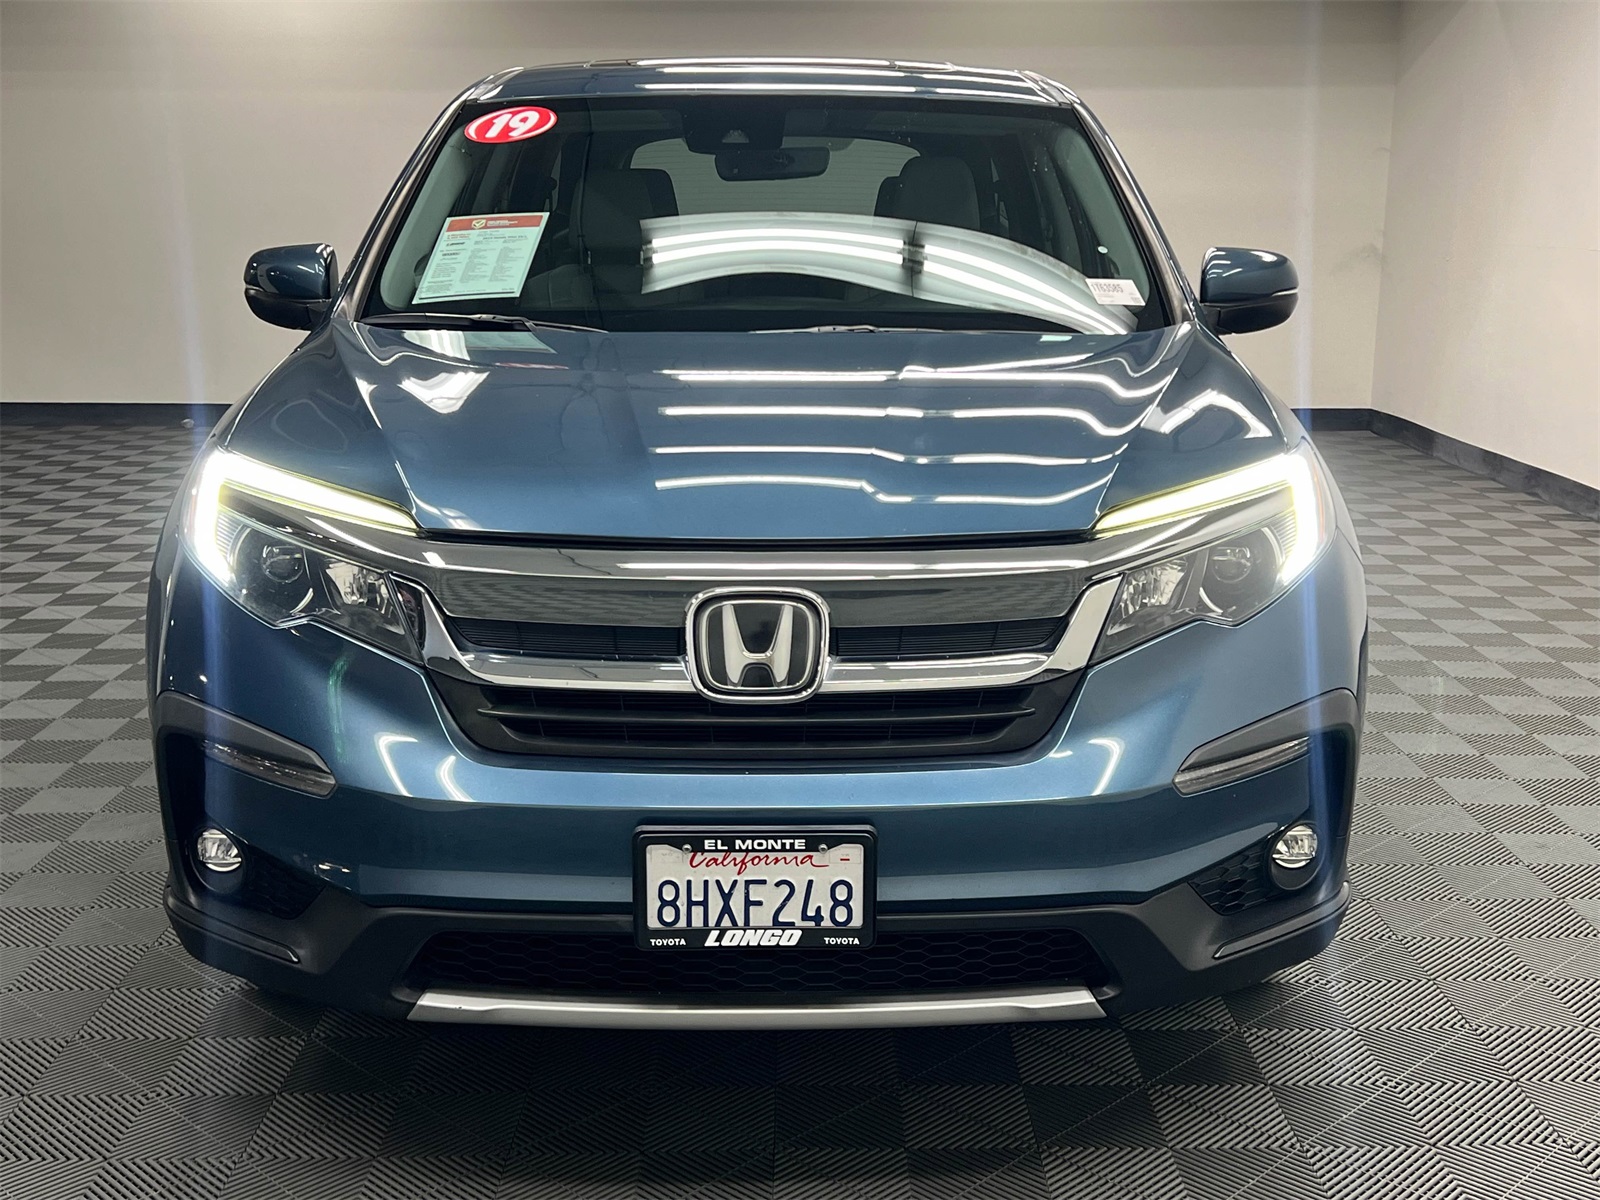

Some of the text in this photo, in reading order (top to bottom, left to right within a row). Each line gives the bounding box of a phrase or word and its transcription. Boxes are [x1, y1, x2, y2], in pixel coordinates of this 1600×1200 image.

[485, 110, 540, 138] 19
[704, 839, 806, 850] EL MONTE
[689, 851, 830, 876] California
[657, 879, 854, 928] 8HXF248
[650, 938, 687, 946] TOYOTA
[704, 929, 803, 947] LONGO
[824, 937, 860, 945] TOYOTA
